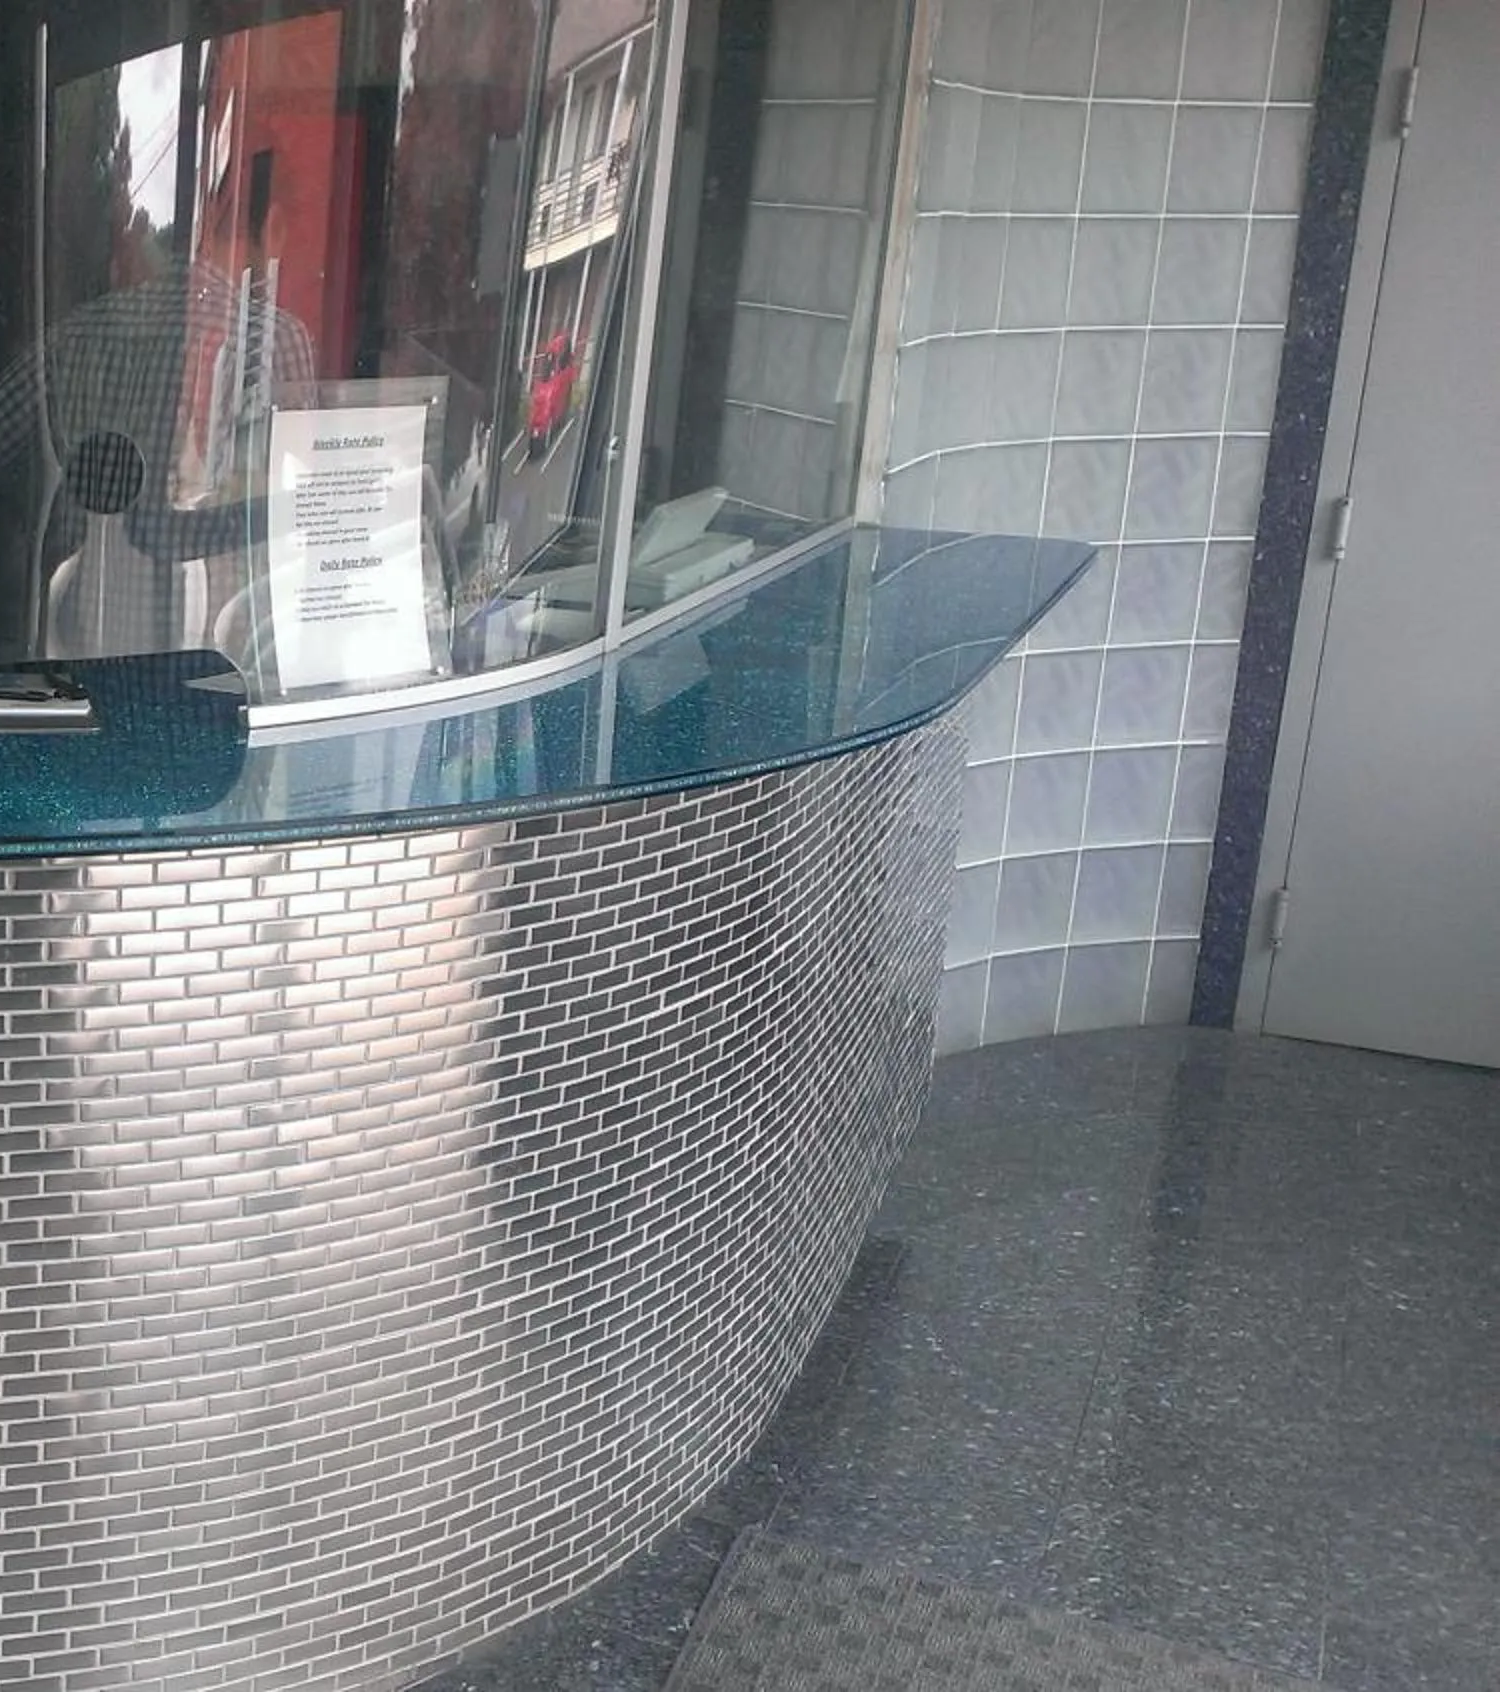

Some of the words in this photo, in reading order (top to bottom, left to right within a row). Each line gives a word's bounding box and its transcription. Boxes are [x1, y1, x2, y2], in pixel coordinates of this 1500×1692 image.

[341, 436, 360, 449] Rate
[360, 435, 384, 448] Policy
[320, 559, 341, 571] Daily
[341, 557, 360, 570] Rate
[360, 556, 382, 568] Policy
